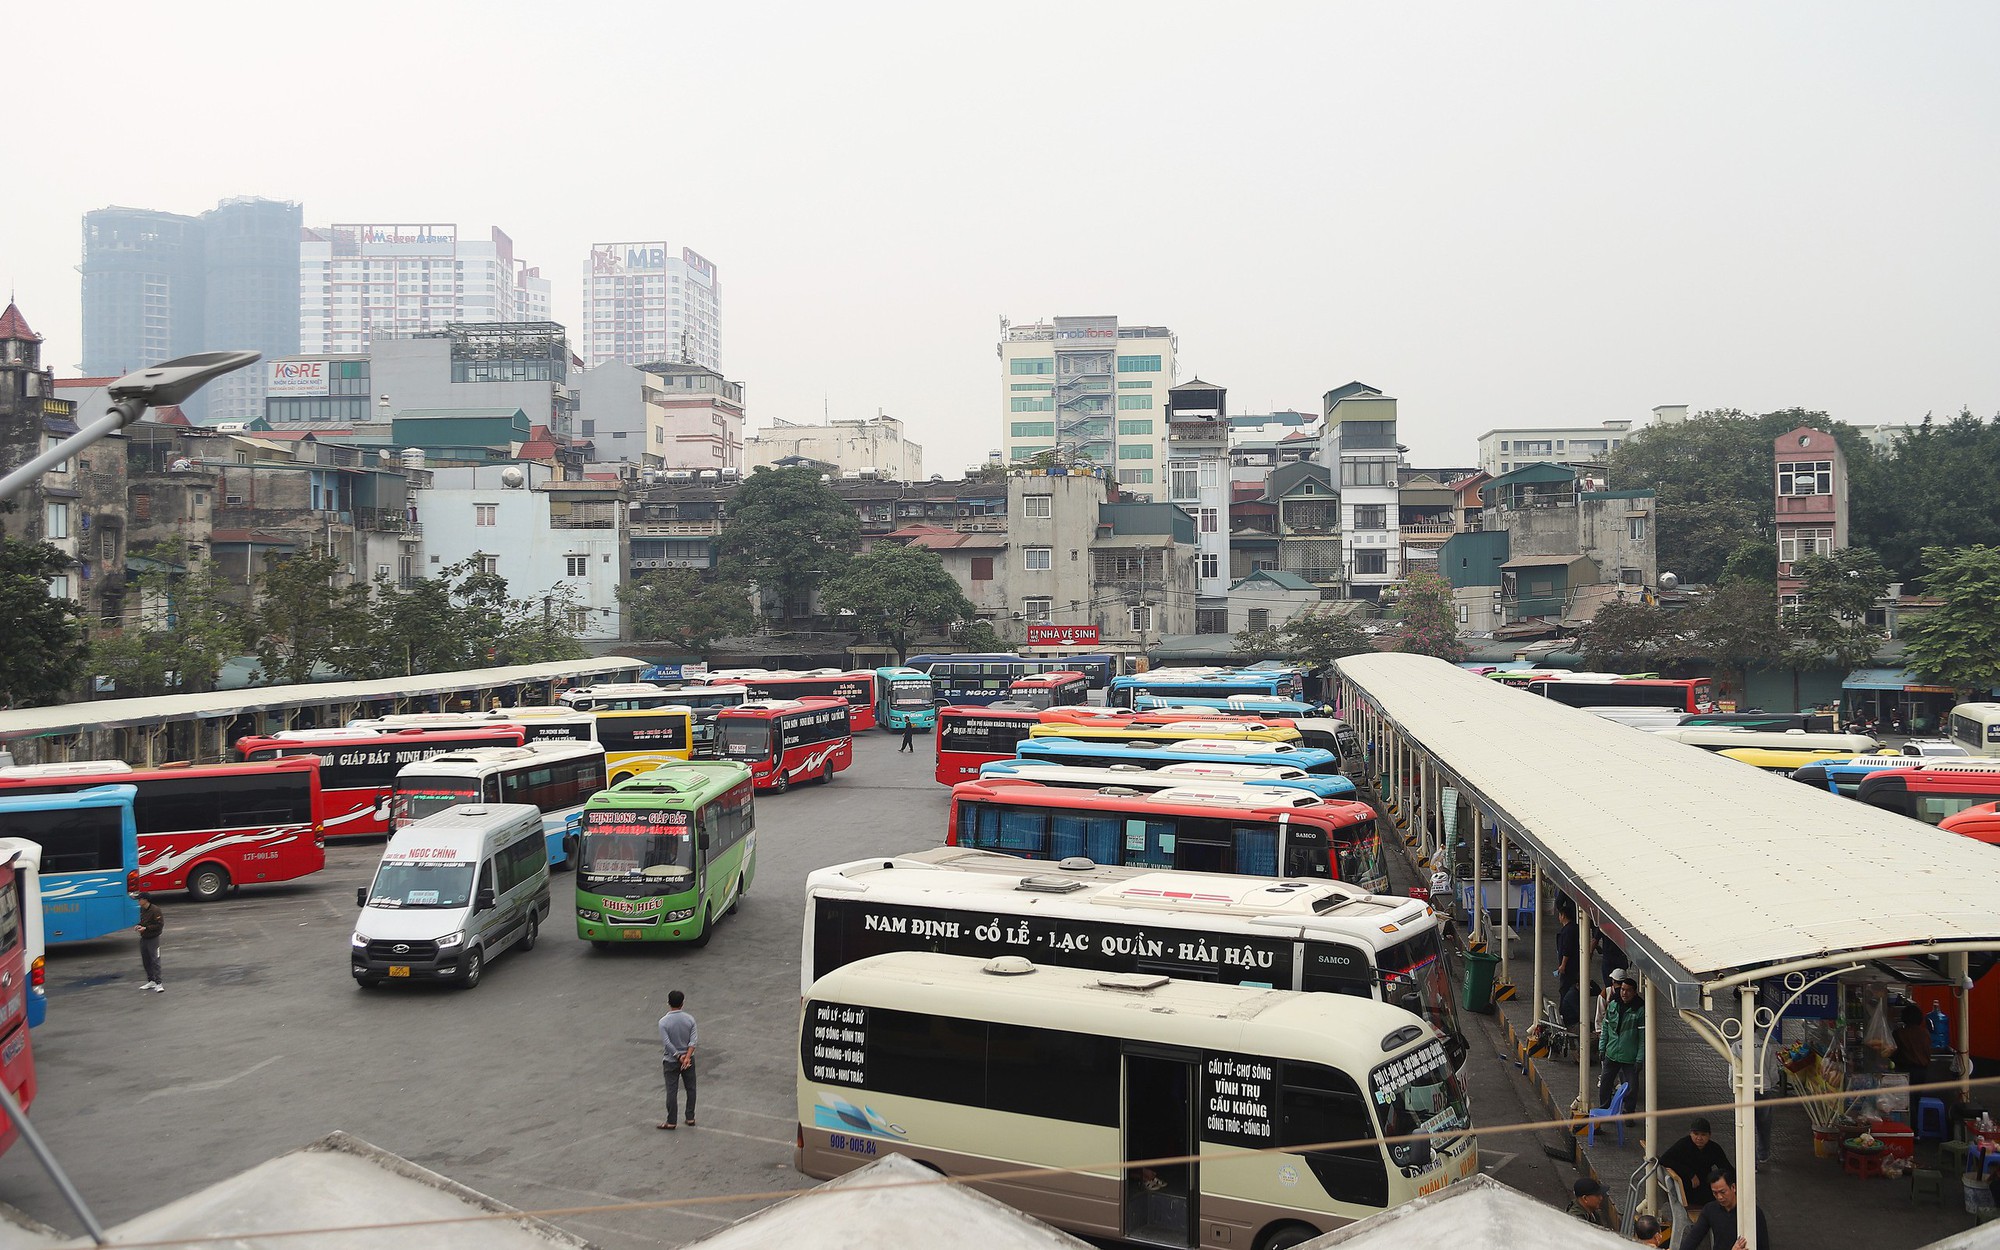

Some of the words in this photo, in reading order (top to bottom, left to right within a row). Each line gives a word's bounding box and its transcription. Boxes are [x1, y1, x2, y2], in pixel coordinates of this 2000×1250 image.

[628, 249, 664, 268] MB
[1056, 328, 1114, 338] mobifone
[1040, 628, 1060, 638] NHÀ
[1062, 628, 1073, 640] VỆ
[1074, 630, 1096, 638] SINH
[340, 750, 365, 766] GIÁP
[367, 749, 391, 765] BÁT
[395, 750, 420, 764] NINH
[588, 812, 614, 825] THỊNH
[614, 812, 636, 824] LONG
[648, 810, 669, 824] GIÁP
[669, 811, 687, 825] BÁT
[1354, 813, 1368, 821] VIP
[636, 897, 664, 912] HIẾU
[864, 914, 906, 933] NAM
[911, 918, 960, 940] ĐỊNH
[975, 917, 1002, 942] CỔ
[1006, 920, 1030, 945] LỄ
[1049, 931, 1089, 953] LẠC
[1100, 932, 1163, 958] QUẦN
[1178, 939, 1218, 963] HẢI
[1224, 945, 1274, 970] HẬU
[1318, 955, 1350, 965] SAMCO
[1806, 994, 1828, 1008] TRỤ
[818, 1006, 830, 1020] PHỦ
[831, 1007, 839, 1021] LÝ
[815, 1026, 826, 1041] CHỢ
[855, 1031, 865, 1046] TRỤ
[814, 1065, 825, 1080] CHỢ
[850, 1069, 864, 1083] TRÁC
[1236, 1064, 1251, 1080] CHỢ
[1252, 1063, 1271, 1080] SÔNG
[1215, 1078, 1238, 1095] VĨNH
[1241, 1083, 1260, 1101] TRỤ
[1210, 1095, 1230, 1112] CẦU
[1232, 1100, 1267, 1118] KHÔNG
[1207, 1114, 1224, 1131] CỐNG
[1243, 1119, 1260, 1136] CỐNG
[1261, 1120, 1270, 1137] ĐỎ
[830, 1134, 876, 1155] 90B-005.84
